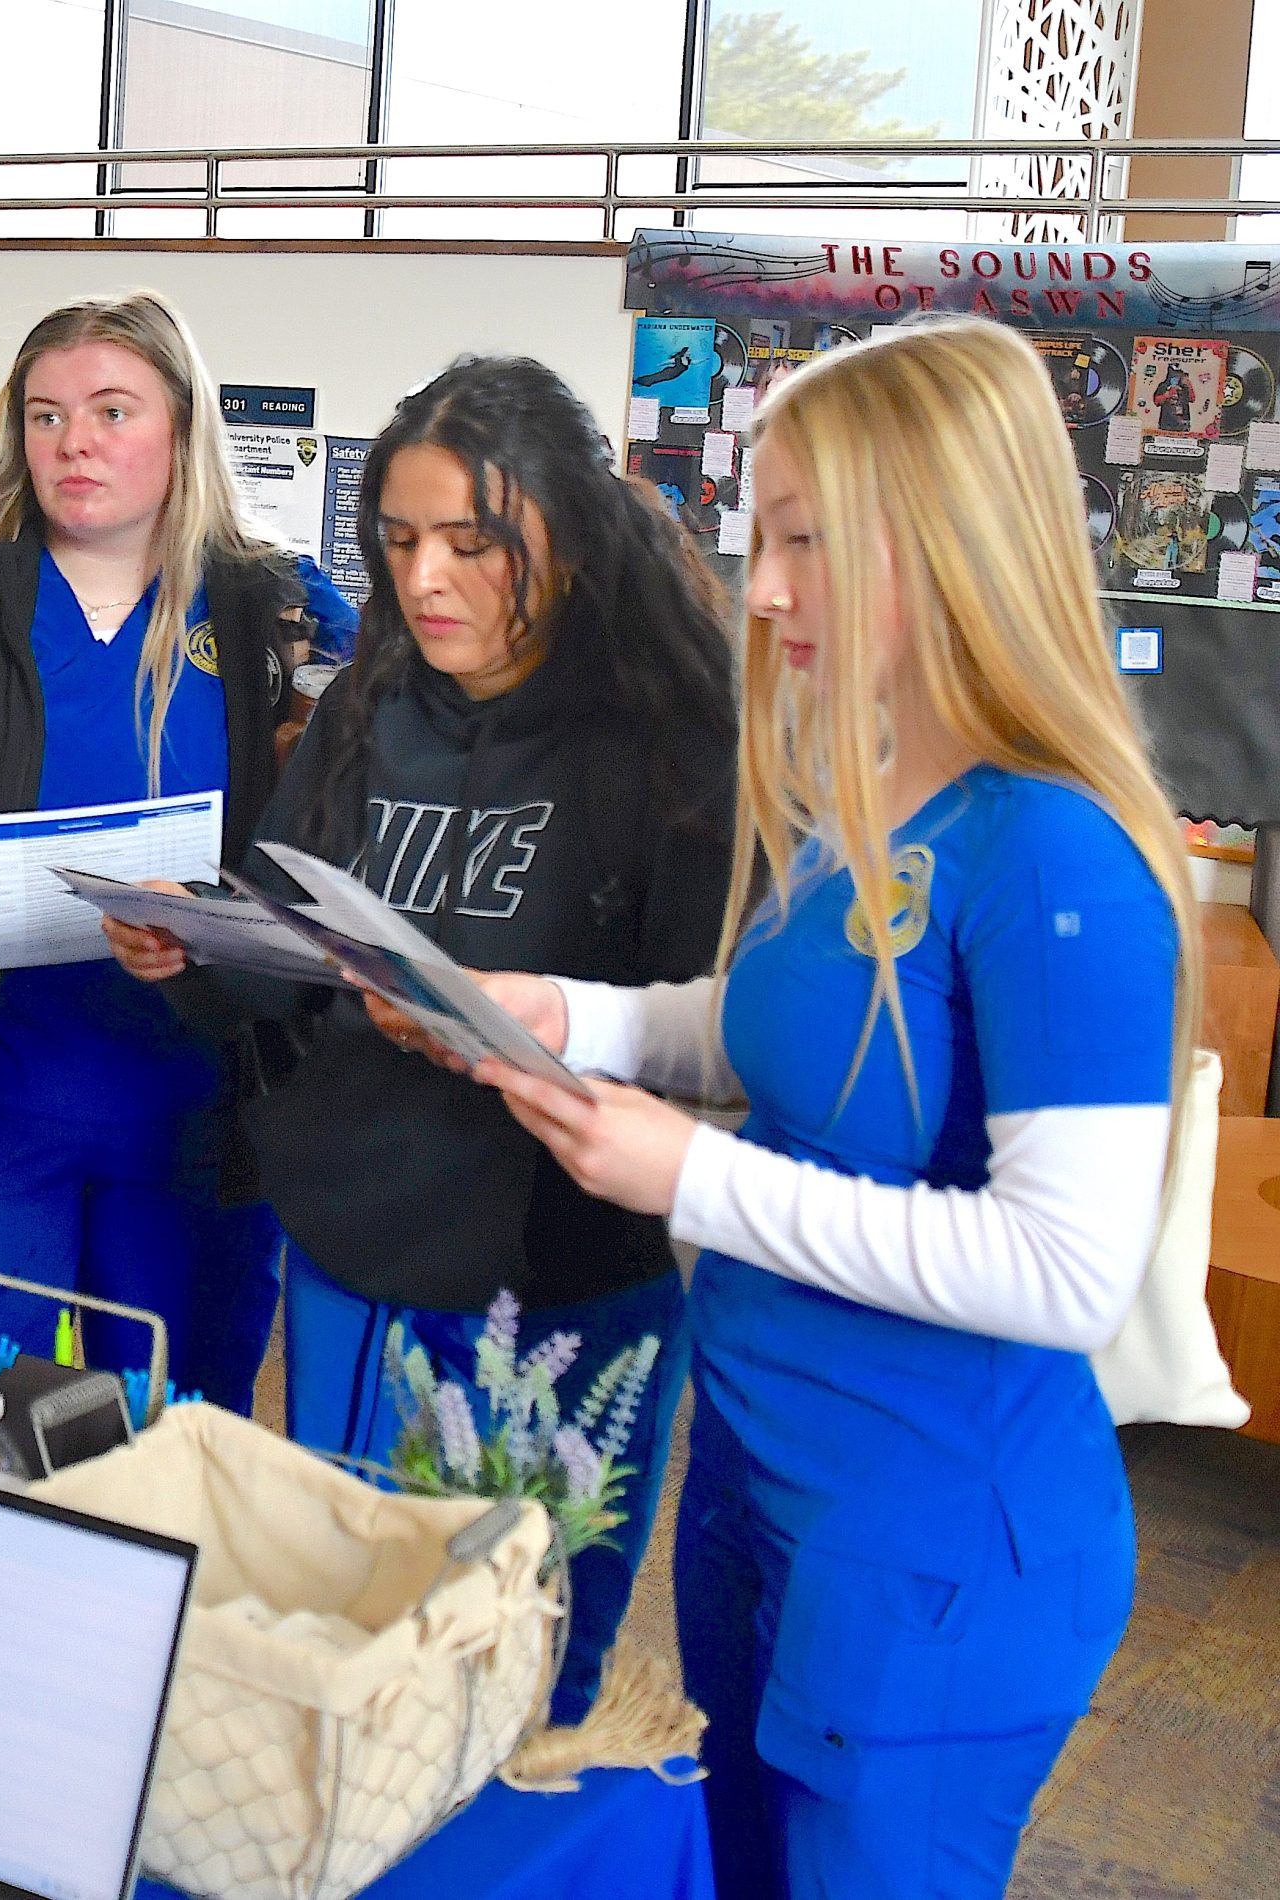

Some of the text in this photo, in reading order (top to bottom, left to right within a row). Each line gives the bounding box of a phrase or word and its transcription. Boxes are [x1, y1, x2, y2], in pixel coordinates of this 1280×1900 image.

[821, 243, 1152, 282] THE SOUNDS
[874, 284, 1125, 319] OF ASWN
[1154, 342, 1209, 357] Sher
[1152, 355, 1207, 363] Treasurer
[223, 399, 305, 412] 301 READING
[227, 433, 291, 445] niversity Police
[226, 444, 272, 455] partment
[332, 447, 366, 461] Safety
[347, 797, 555, 919] NIKE
